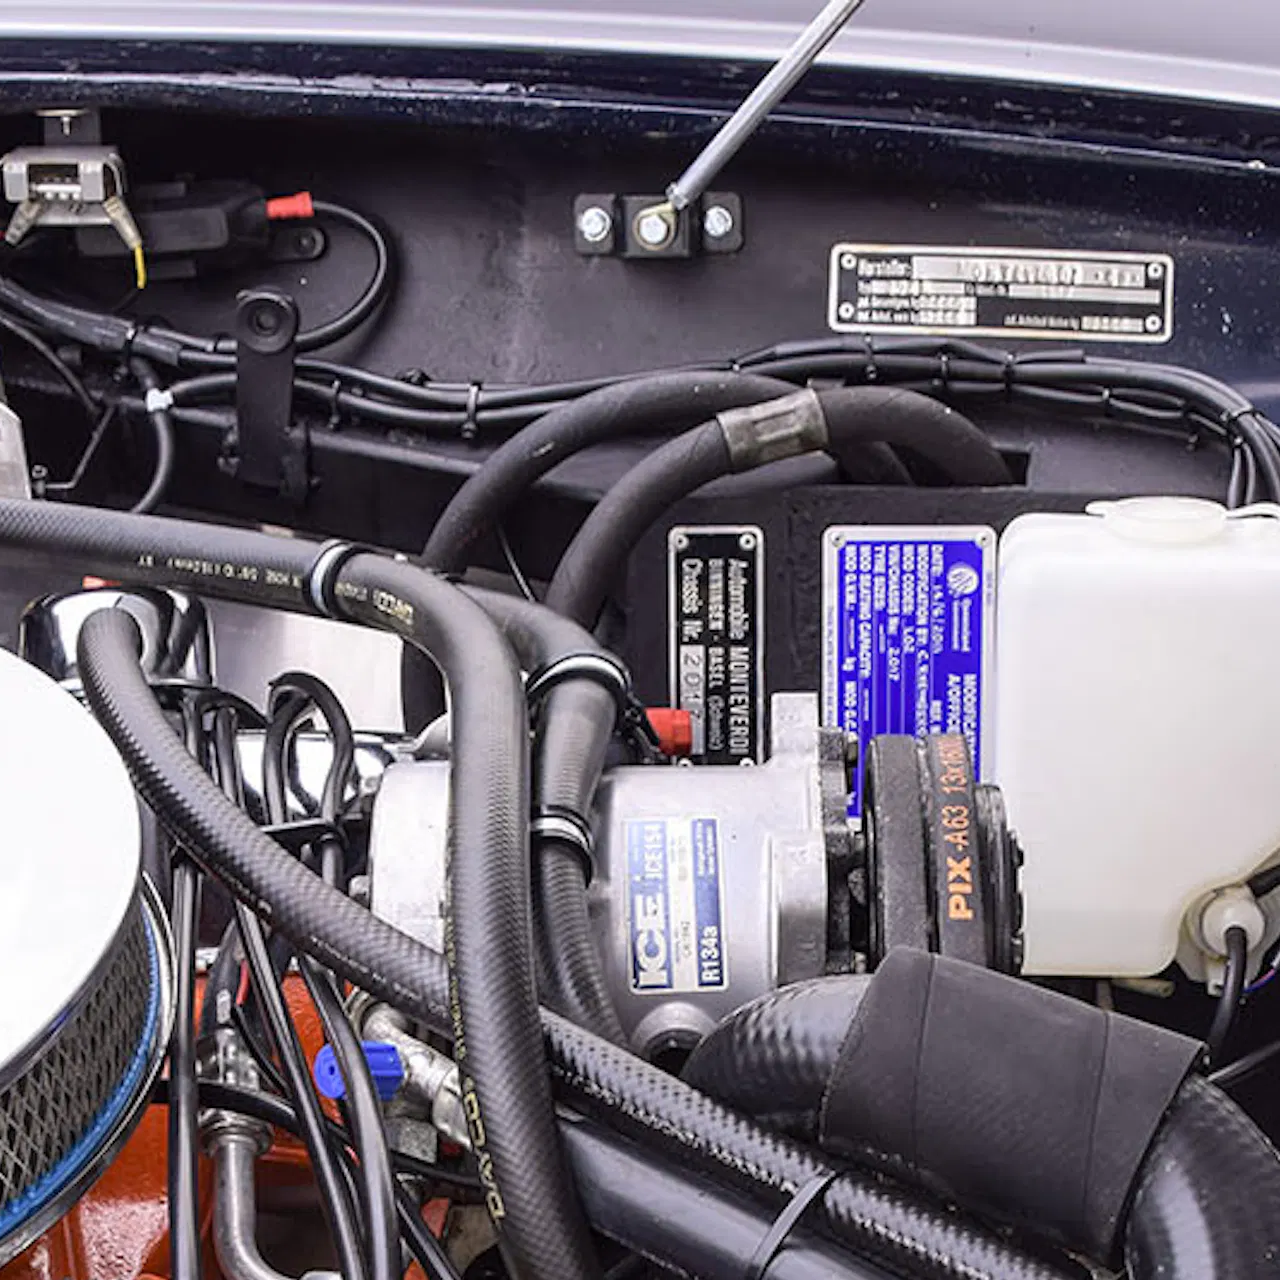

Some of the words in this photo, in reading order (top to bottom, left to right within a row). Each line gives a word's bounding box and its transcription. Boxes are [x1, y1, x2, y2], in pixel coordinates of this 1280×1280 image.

[845, 544, 857, 571] MOD
[860, 544, 871, 571] MOD
[874, 544, 885, 573] TYRE
[902, 544, 914, 571] MOD
[682, 559, 704, 613] Chassis
[708, 559, 724, 631] BINNINGEN
[729, 559, 749, 639] Automobile
[860, 574, 871, 621] SEATING
[902, 574, 914, 615] CODES:
[916, 544, 928, 625] MODIFICATION
[683, 620, 703, 642] Nr.
[708, 647, 723, 689] BASEL
[730, 646, 749, 755] MONTEVERDI
[946, 856, 973, 920] PIX
[632, 891, 669, 987] ICE
